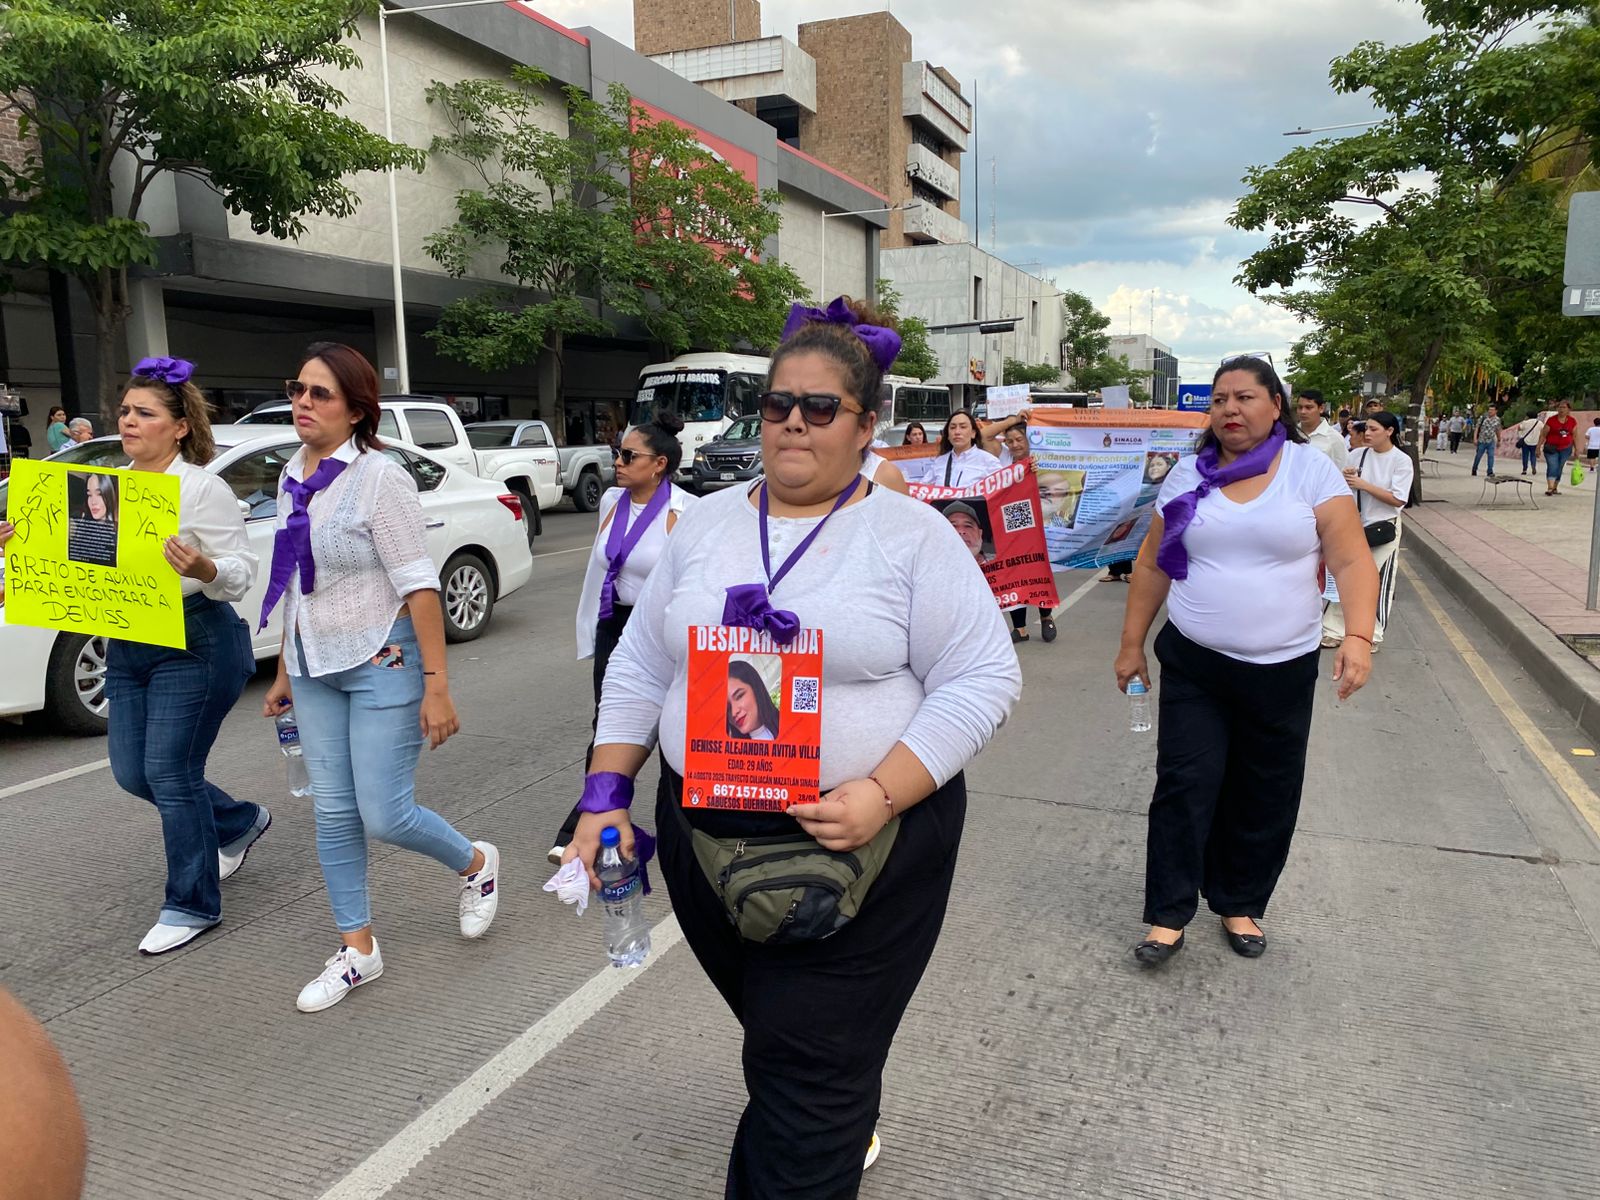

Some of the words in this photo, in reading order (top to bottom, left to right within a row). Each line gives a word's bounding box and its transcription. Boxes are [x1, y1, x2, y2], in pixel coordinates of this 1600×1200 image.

[686, 373, 720, 385] ABASTOS
[1045, 439, 1071, 447] Sinaloa
[909, 463, 1025, 500] ESAPARECIDO
[125, 477, 177, 516] BASTA
[10, 553, 70, 579] GRITO
[75, 566, 97, 583] DE
[980, 560, 1004, 574] ÑONEZ
[1005, 553, 1045, 568] GASTELUM
[10, 578, 58, 597] PARA
[64, 585, 153, 608] ENCONTRAR
[159, 594, 172, 610] A
[690, 739, 723, 754] DENISSE
[725, 740, 770, 757] ALEJANDRA
[771, 743, 797, 759] AVITIA
[728, 758, 745, 770] EDAD:
[746, 760, 755, 771] 29
[756, 758, 773, 772] AÑOS
[725, 773, 749, 783] TRAYECTO
[713, 783, 789, 800] 6671571930
[706, 795, 741, 810] SABUESOS
